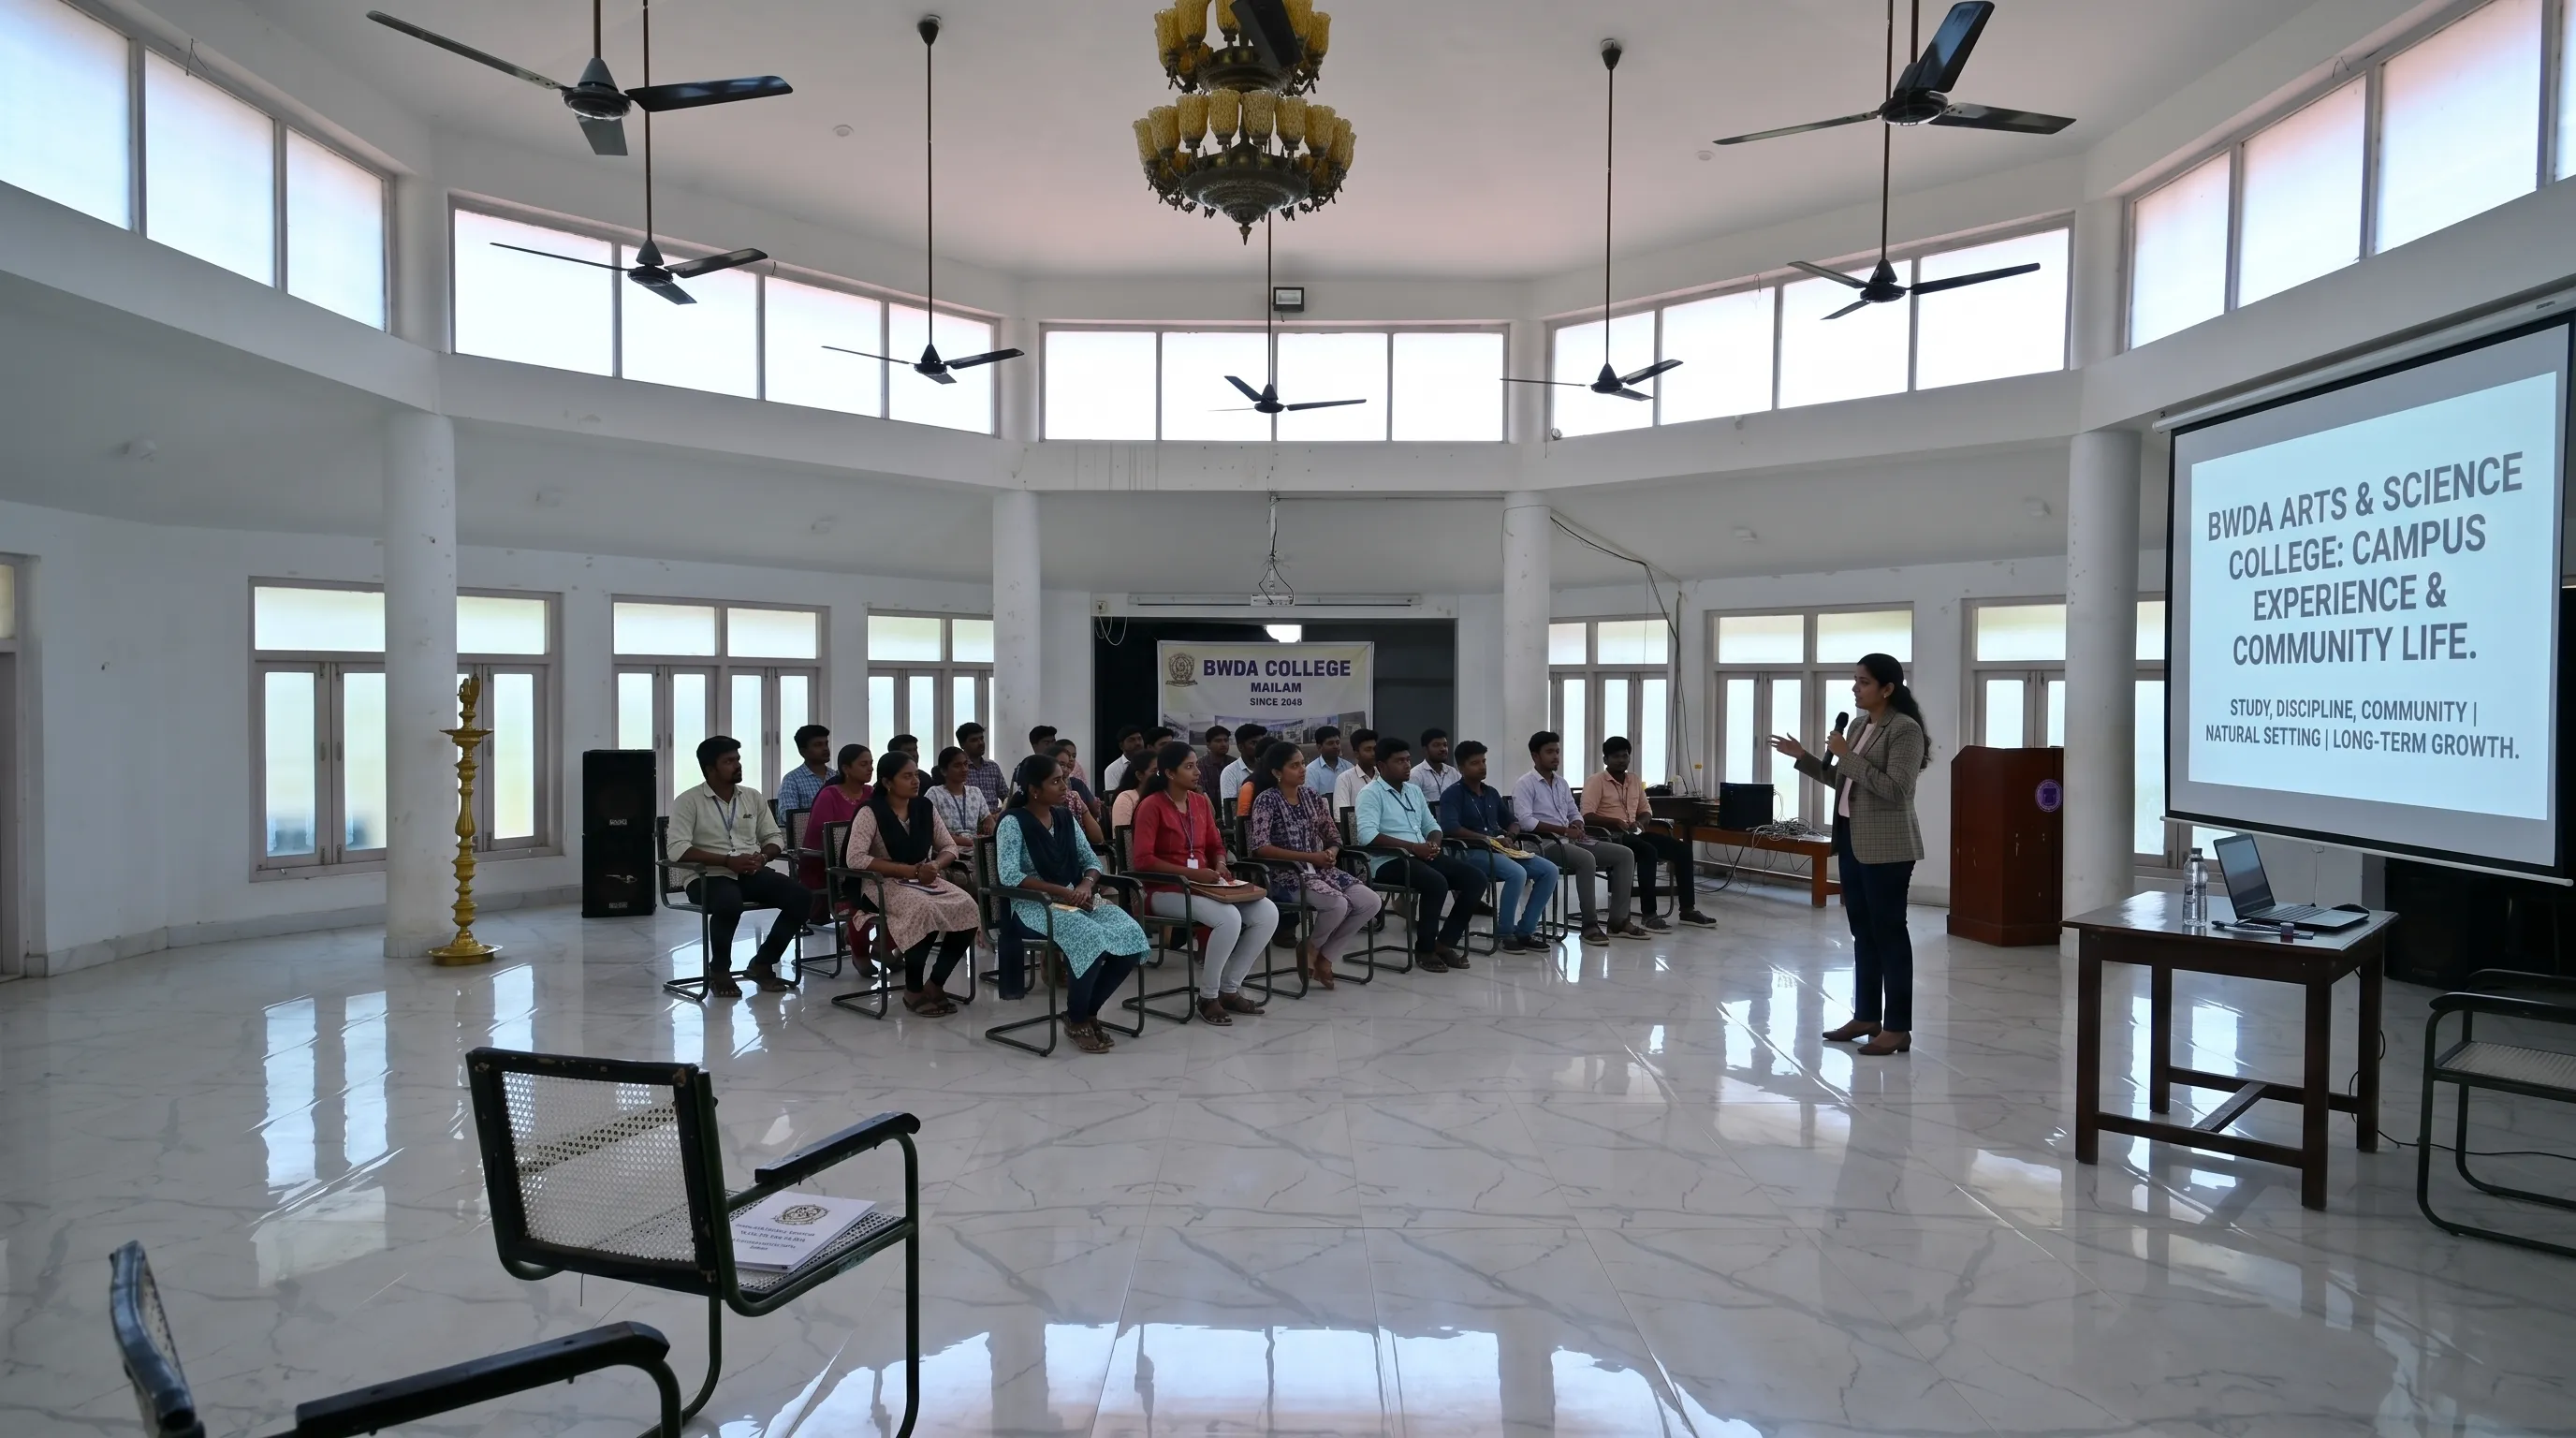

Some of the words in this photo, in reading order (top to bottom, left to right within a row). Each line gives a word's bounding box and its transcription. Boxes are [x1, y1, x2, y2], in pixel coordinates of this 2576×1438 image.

[2208, 501, 2275, 542] BWDA
[2278, 486, 2348, 531] ARTS
[2354, 481, 2375, 517] &
[2382, 450, 2524, 512] SCIENCE
[2230, 535, 2343, 580] COLLEGE:
[2352, 513, 2487, 566] CAMPUS
[2254, 574, 2417, 622] EXPERIENCE
[2424, 571, 2448, 609] &
[2233, 626, 2393, 667] COMMUNITY
[2402, 622, 2477, 661] LIFE.
[1203, 659, 1259, 677] BWDA
[1265, 659, 1352, 677] COLLEGE
[1249, 697, 1279, 707] SINCE
[1281, 697, 1303, 707] 2048
[1251, 682, 1302, 694] MAILAM
[2230, 697, 2273, 723] STUDY,
[2276, 698, 2357, 724] DISCIPLINE,
[2361, 699, 2468, 724] COMMUNITY
[2205, 724, 2261, 745] NATURAL
[2262, 726, 2321, 749] SETTING
[2333, 728, 2427, 755] LONG-TERM
[2431, 732, 2520, 760] GROWTH.
